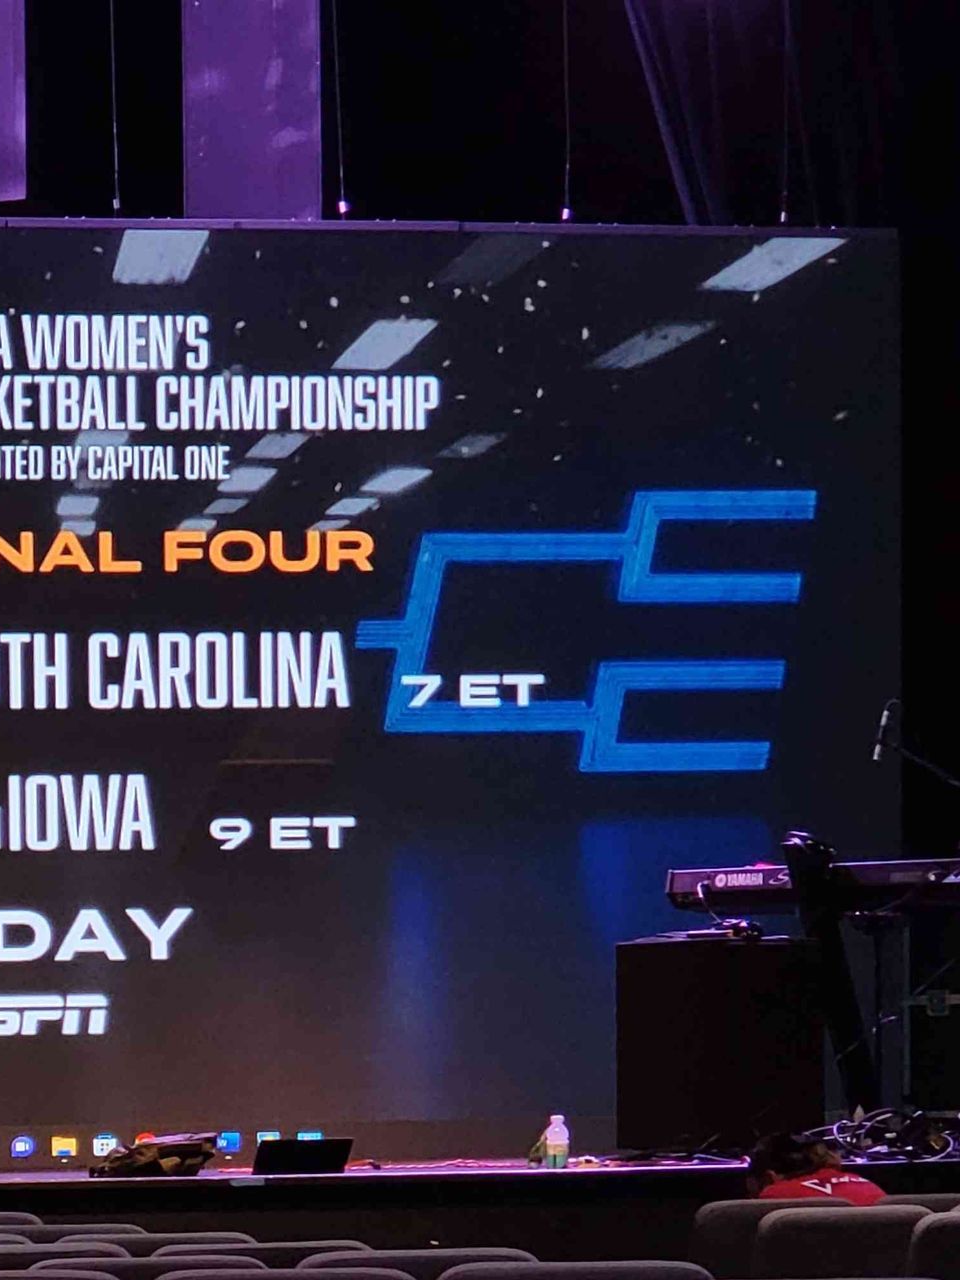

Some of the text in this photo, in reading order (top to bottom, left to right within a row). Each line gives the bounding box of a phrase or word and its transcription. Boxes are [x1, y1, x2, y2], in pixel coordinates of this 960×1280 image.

[21, 314, 208, 370] WOMEN'S
[156, 376, 438, 430] CHAMPIONSHIP
[50, 445, 82, 480] BY
[87, 445, 179, 480] CAPITAL
[183, 445, 232, 480] ONE
[164, 530, 374, 572] FOUR
[88, 632, 349, 709] CAROLINA
[400, 675, 442, 708] 7
[459, 674, 544, 706] ET
[208, 817, 253, 850] 9
[270, 817, 355, 849] ET
[727, 872, 763, 886] YAMAHA
